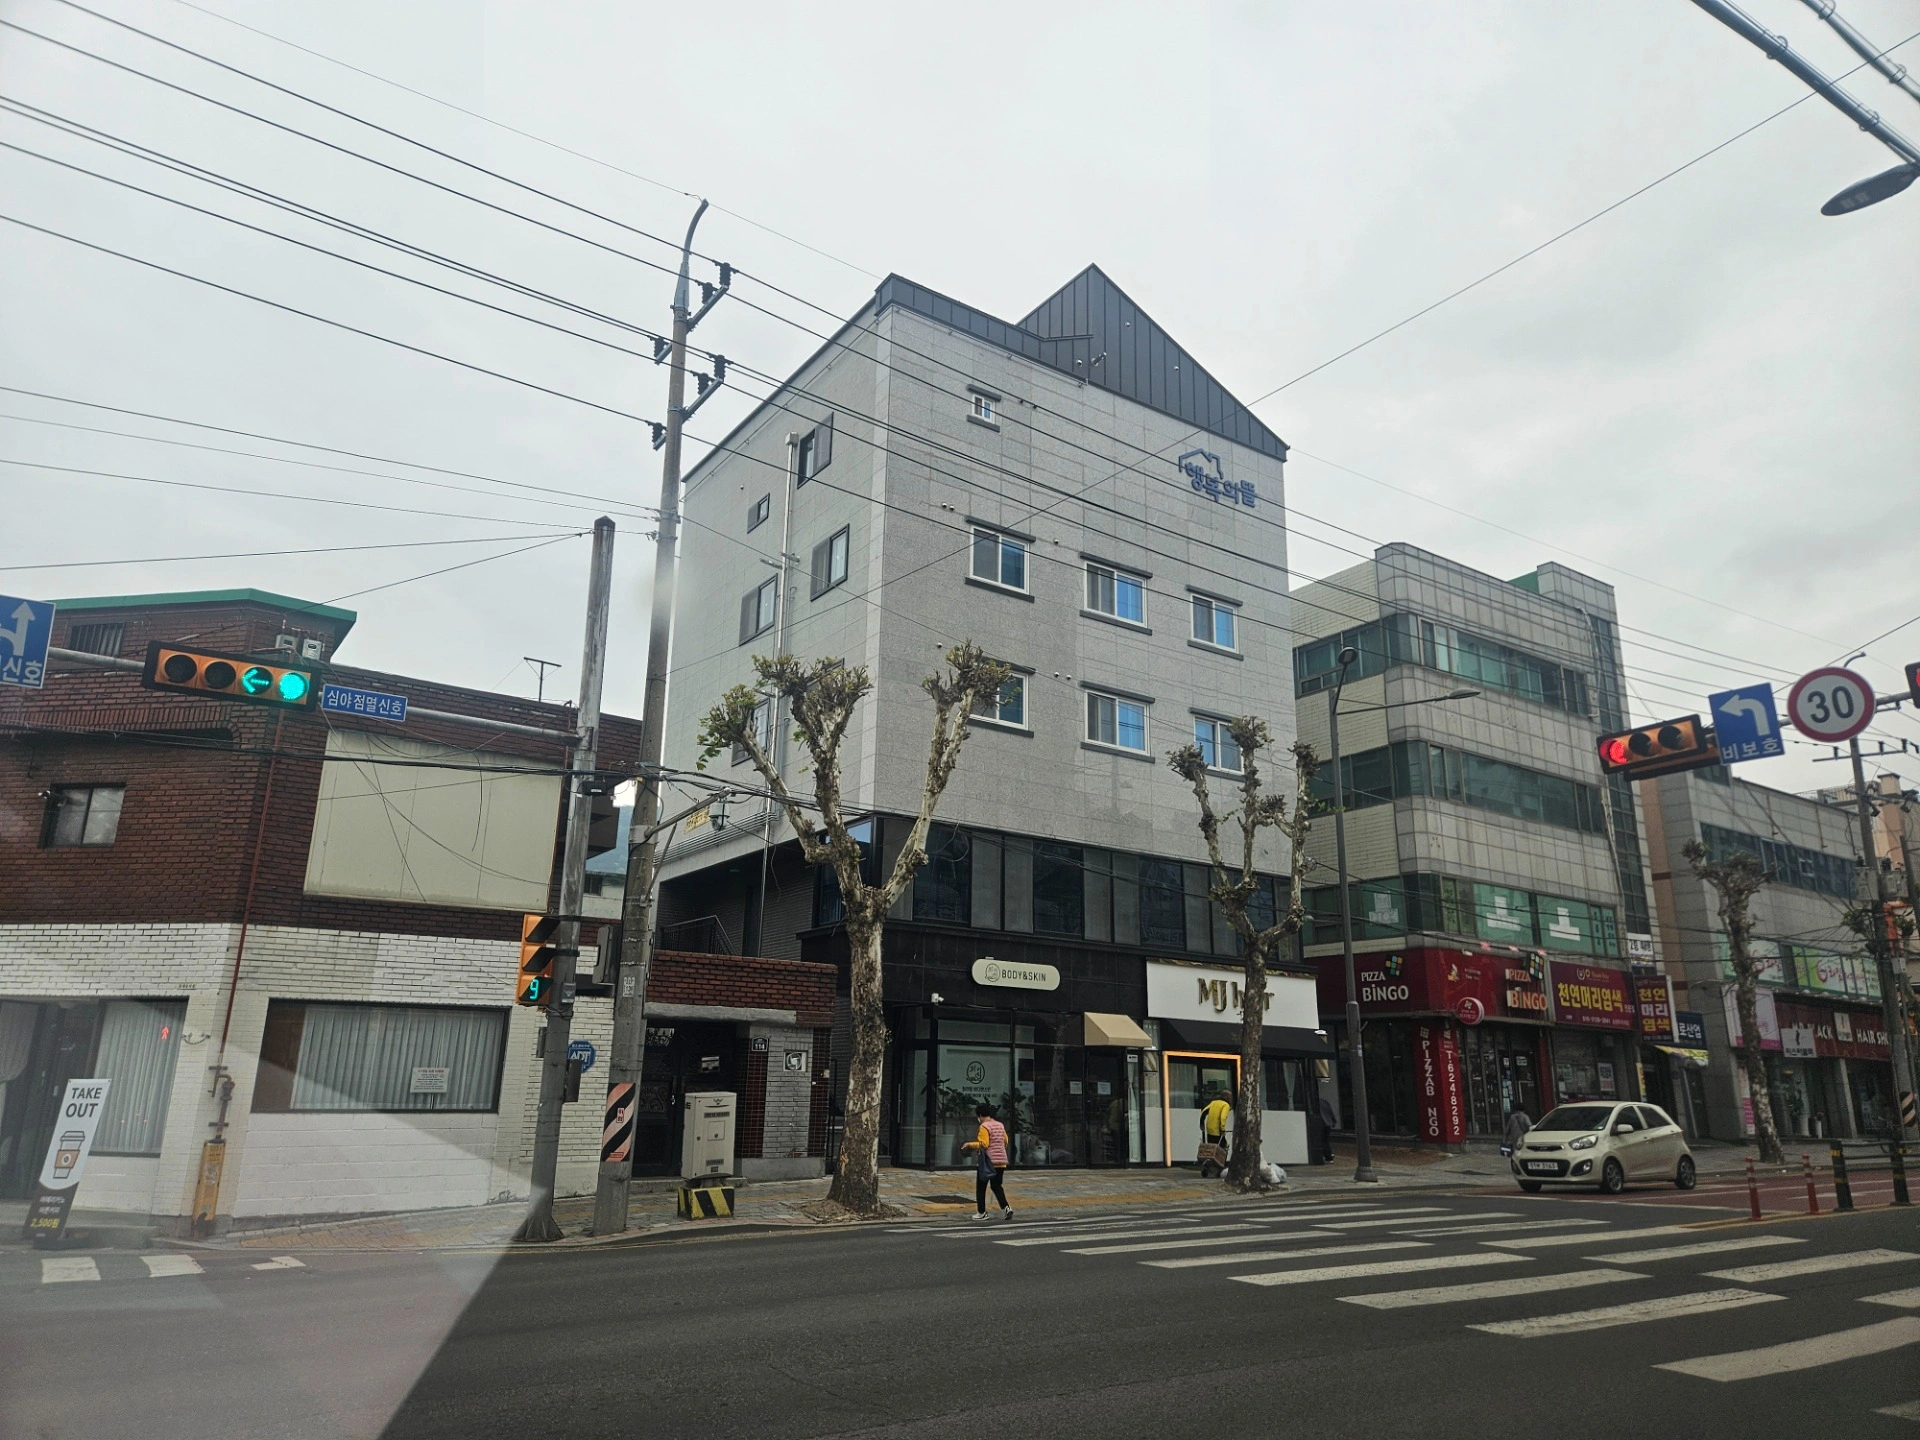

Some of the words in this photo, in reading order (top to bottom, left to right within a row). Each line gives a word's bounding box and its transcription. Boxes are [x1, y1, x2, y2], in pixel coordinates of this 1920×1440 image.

[0, 655, 42, 685] 신호
[1807, 685, 1854, 724] 30
[1722, 737, 1782, 760] 비보호
[1001, 969, 1046, 982] BODY&SKIN
[1361, 971, 1386, 982] PIZZA
[1507, 968, 1531, 982] PIZZA
[529, 979, 539, 1000] 9
[1638, 988, 1667, 1001] 천연
[1558, 982, 1624, 1013] 천연머리염색
[1641, 1004, 1669, 1017] 머리
[1643, 1018, 1671, 1031] 염색
[1856, 1028, 1876, 1044] HAIR
[570, 1050, 591, 1062] ADT
[71, 1087, 103, 1099] TAKE
[65, 1103, 99, 1118] OUT
